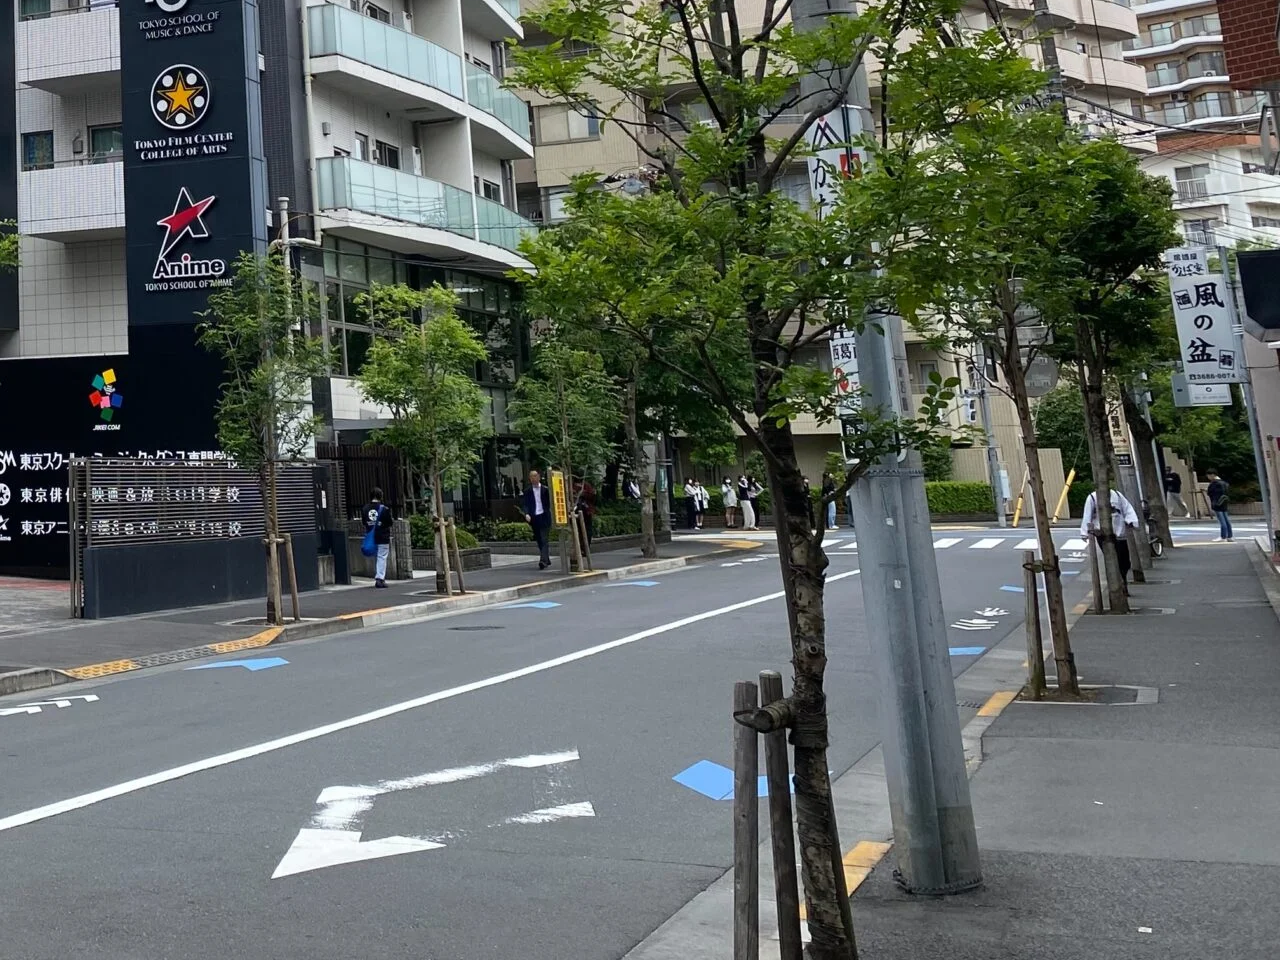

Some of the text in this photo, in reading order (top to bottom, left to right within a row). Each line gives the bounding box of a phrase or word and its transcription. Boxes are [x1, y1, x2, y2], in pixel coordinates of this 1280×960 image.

[139, 11, 220, 30] TOKYO SCHOOL OF
[145, 23, 213, 40] MUSIC & DANCE
[134, 132, 233, 150] TOKYO FILM CENTER
[140, 149, 184, 160] COLLEGE
[201, 144, 227, 155] ARTS
[153, 253, 225, 279] Anime
[145, 283, 168, 291] TOKYO
[169, 280, 197, 290] SCHOOL
[199, 280, 209, 288] OF
[1187, 282, 1225, 363] 風の盆
